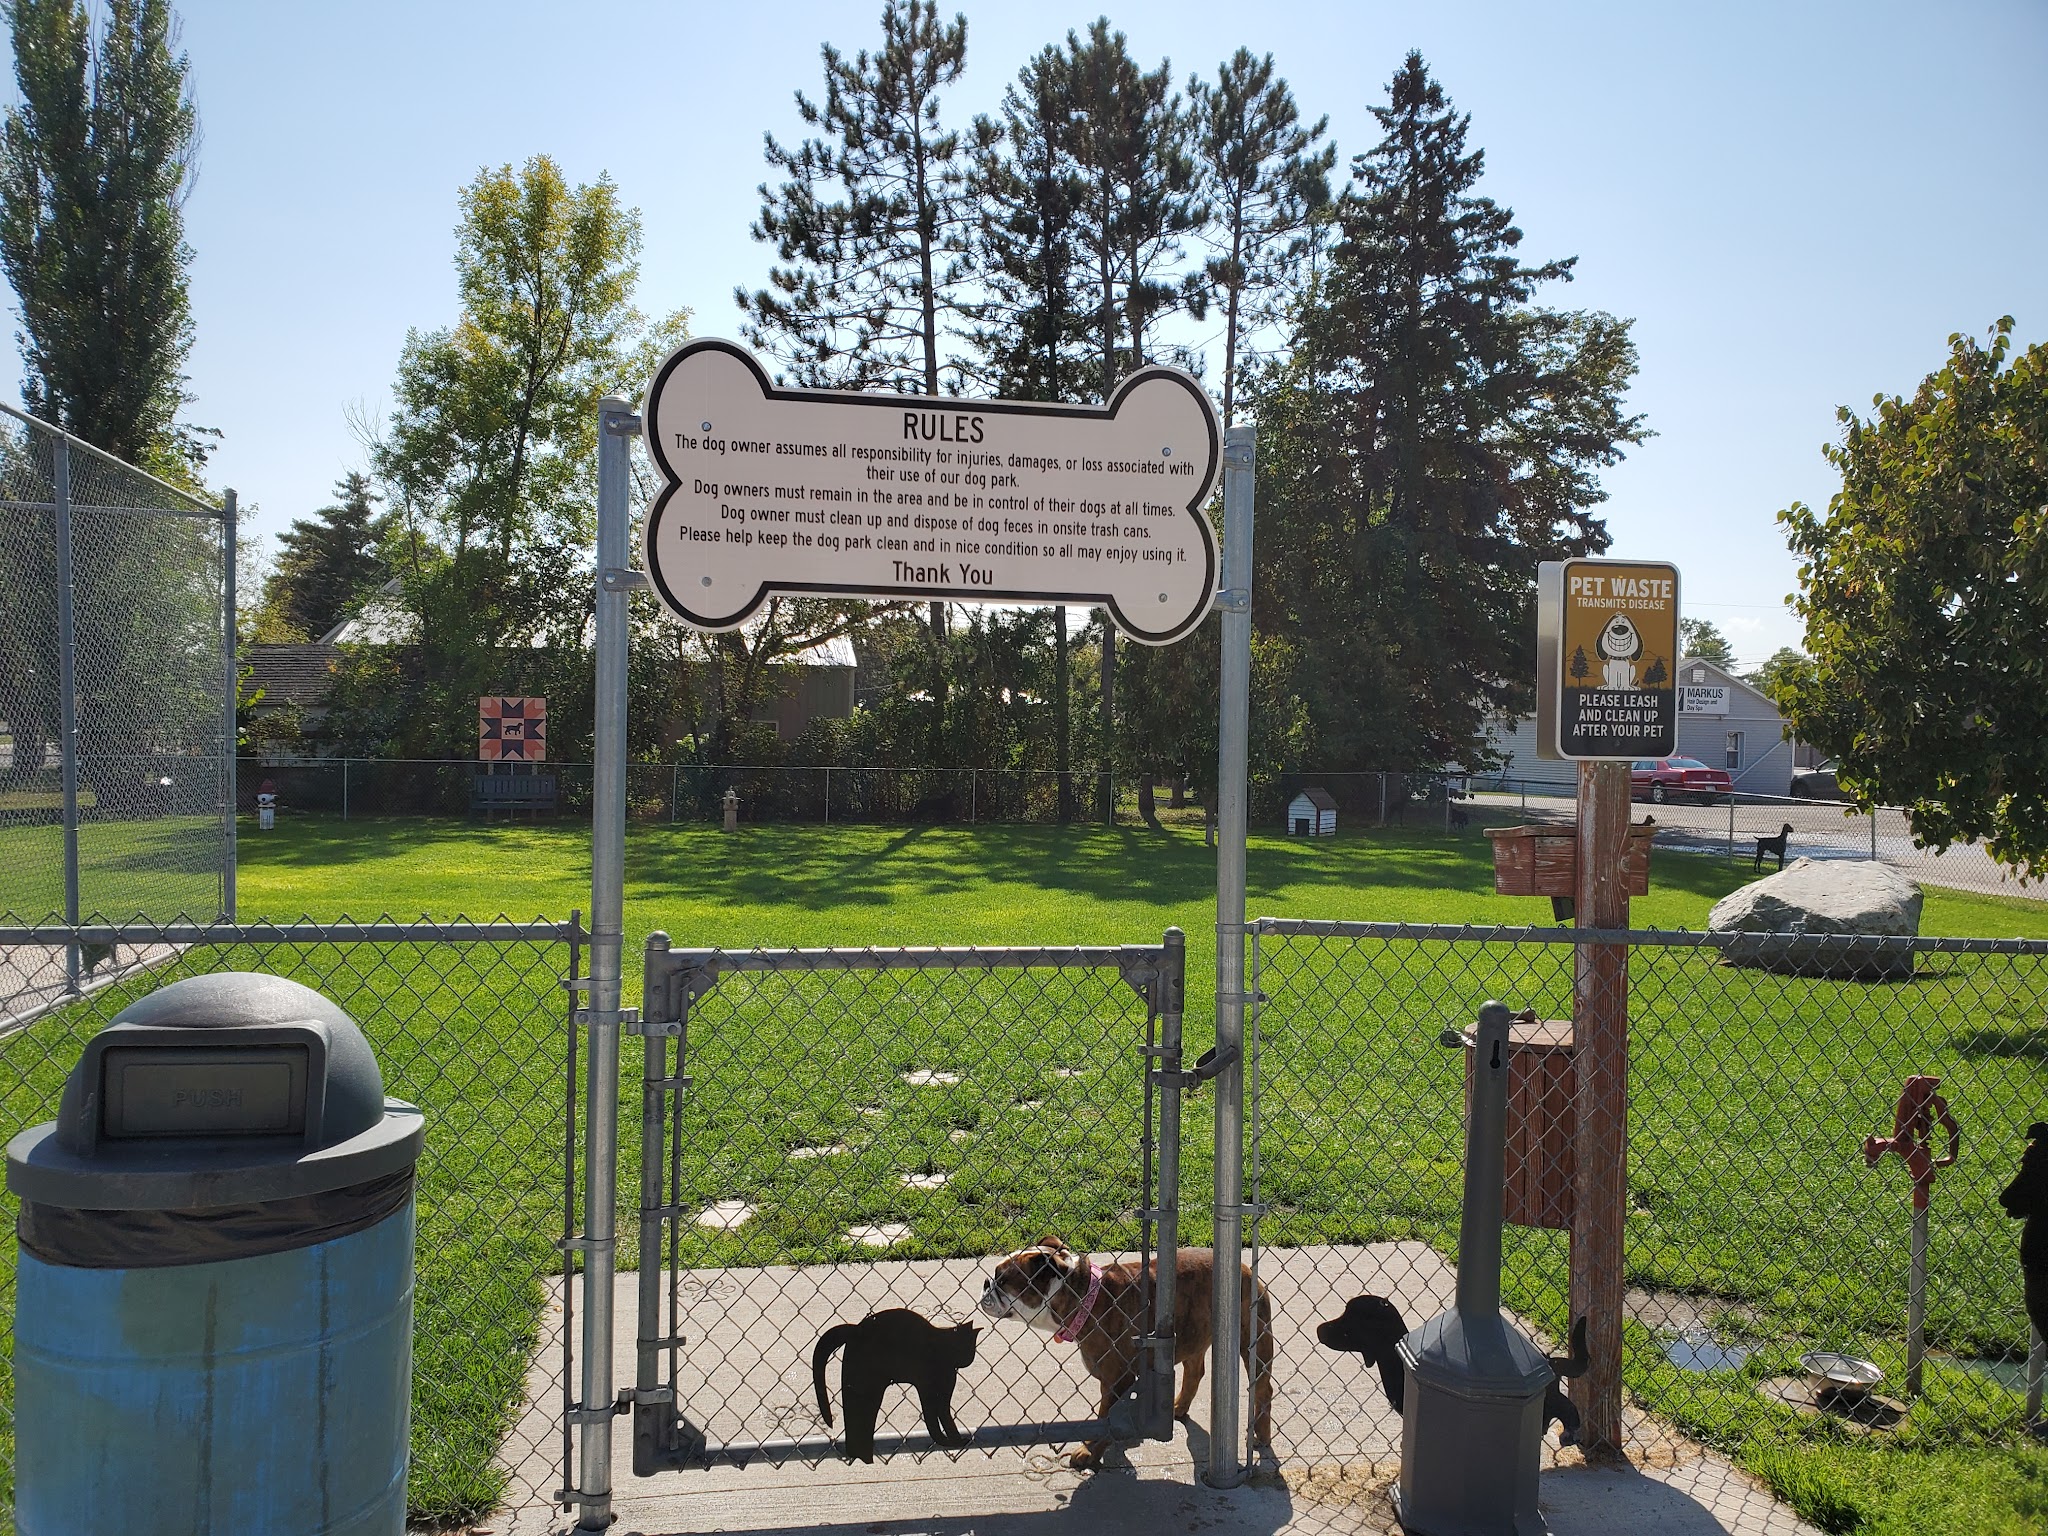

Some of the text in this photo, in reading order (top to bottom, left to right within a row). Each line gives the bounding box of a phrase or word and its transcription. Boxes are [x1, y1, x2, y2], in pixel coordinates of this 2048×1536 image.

[903, 412, 984, 444] RULES
[674, 433, 1194, 476] The dog owner assumes all responsibility for injuries, damages, or loss associated with
[866, 464, 1020, 491] their use of our dog park.
[694, 478, 1176, 519] Dog owners must remain in the area and be in control of their dogs at all times.
[721, 503, 1152, 539] Dog owner must clean up and dispose of dog feces in onsite trash cans.
[679, 525, 1187, 566] Please help keep the dog park clean and in nice condition so all may enjoy using it.
[892, 560, 993, 586] Thank You
[1570, 576, 1672, 598] PET WASTE
[1577, 597, 1665, 610] TRANSMITS DISEASE
[1579, 694, 1658, 708] PLEASE LEASH
[1687, 688, 1724, 699] MARKUS
[1578, 709, 1659, 723] AND CLEAN UP
[1572, 724, 1664, 738] AFTER YOUR PET
[174, 1088, 243, 1108] PUSH
